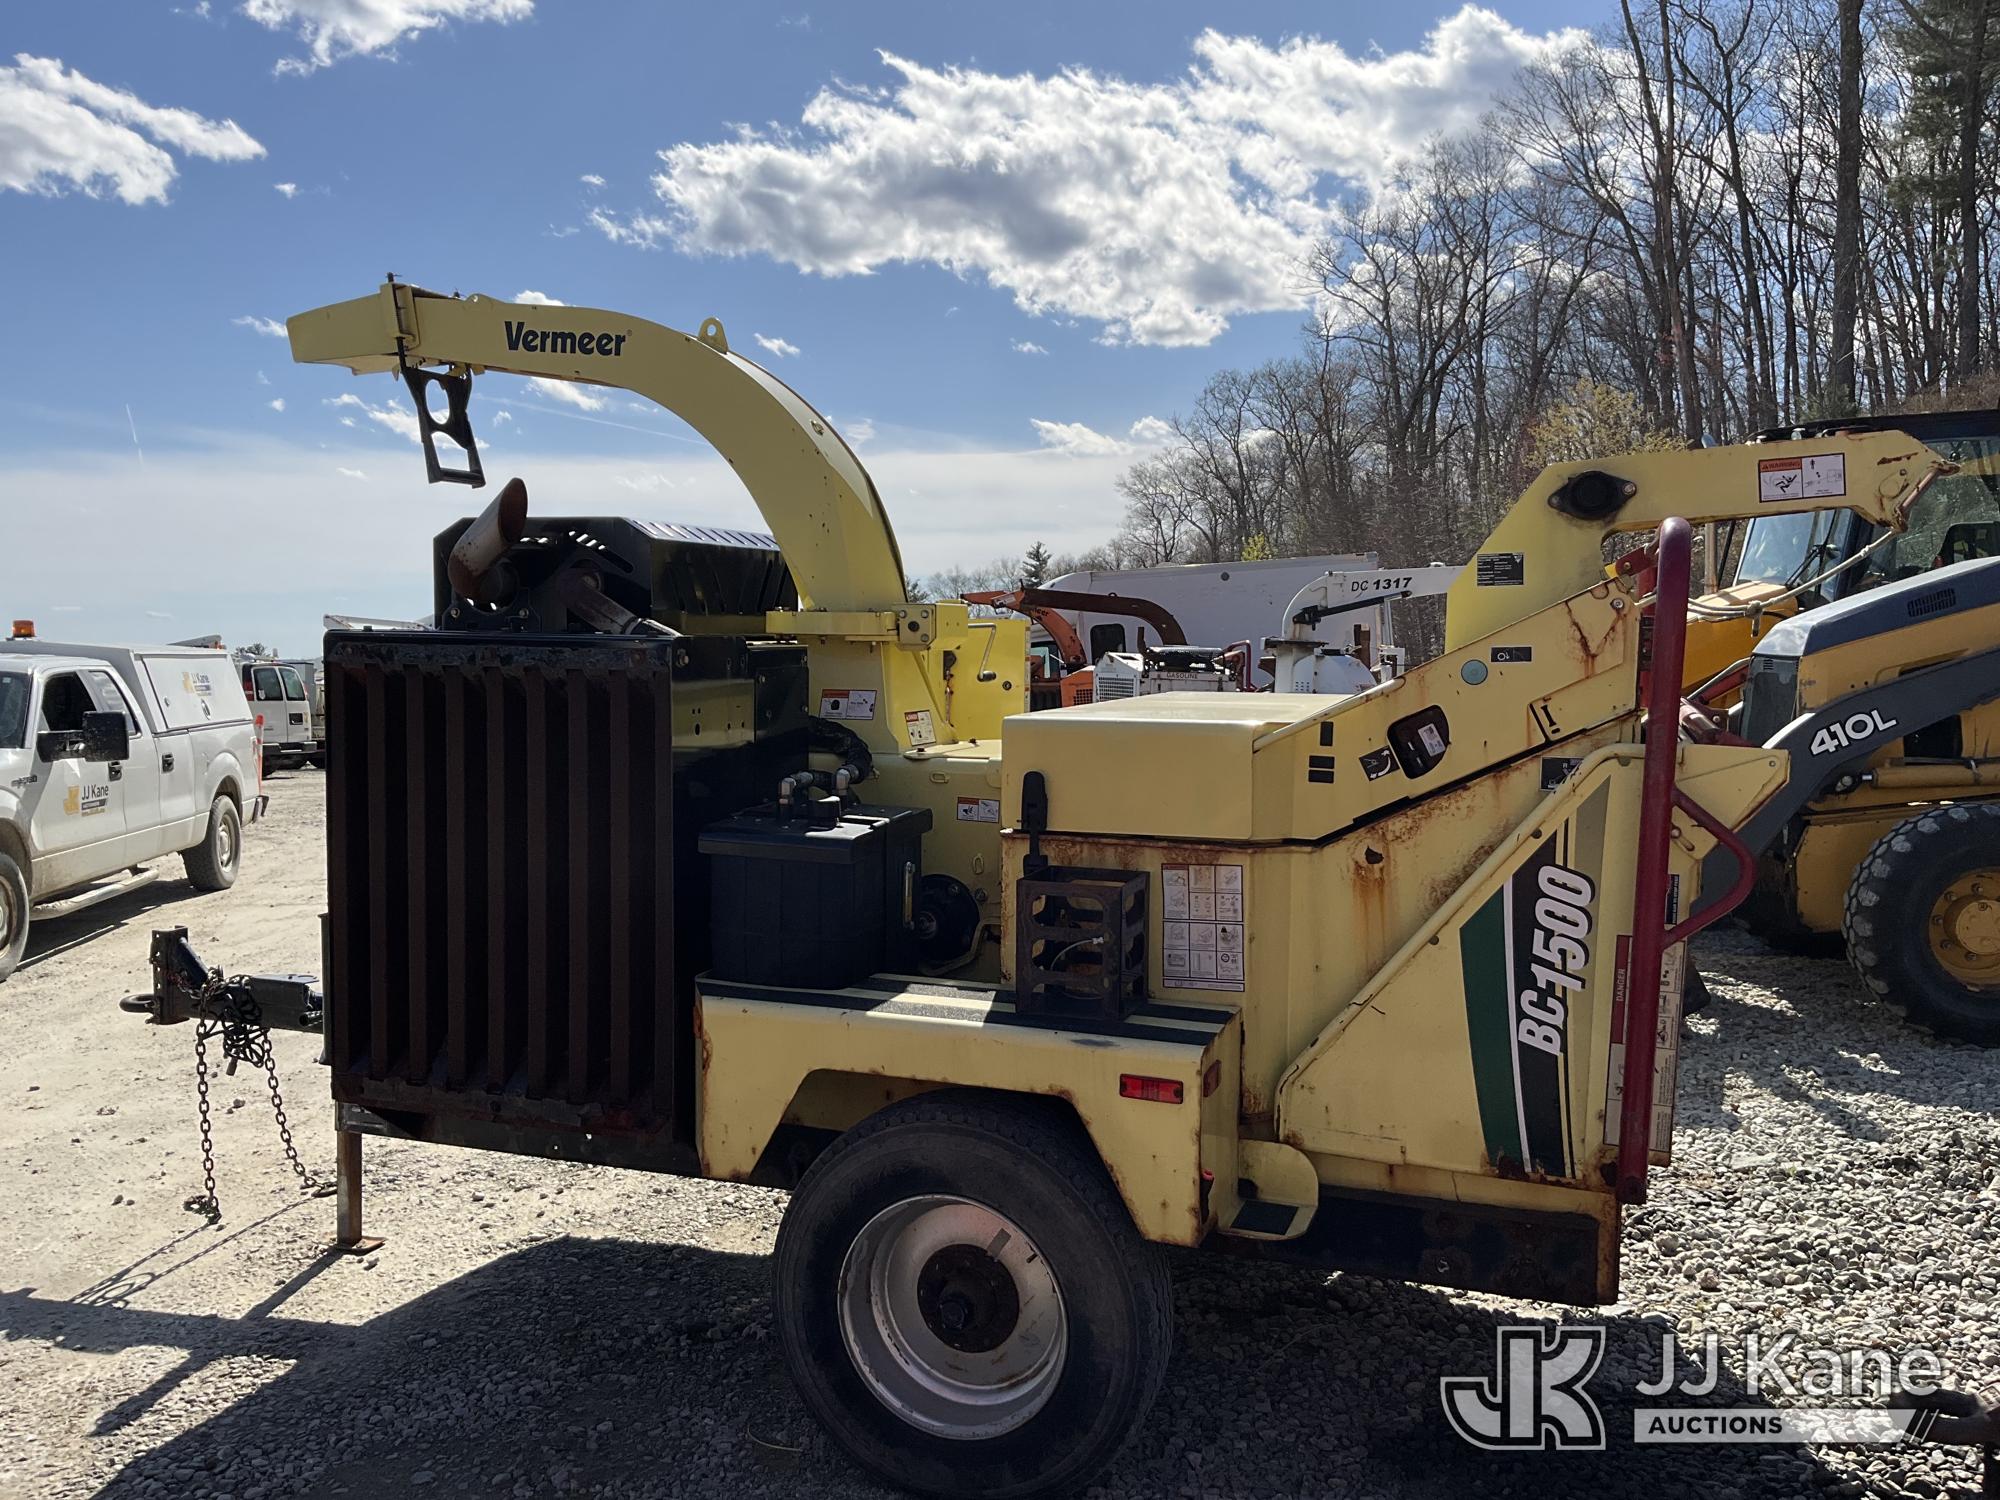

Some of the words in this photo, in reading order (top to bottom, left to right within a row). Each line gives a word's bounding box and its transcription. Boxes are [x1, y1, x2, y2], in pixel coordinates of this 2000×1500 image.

[504, 321, 626, 357] Vermeer
[1351, 581, 1369, 592] DC
[1373, 577, 1412, 590] 1317
[1811, 710, 1897, 755] 410L
[81, 785, 90, 800] JJ
[91, 784, 109, 798] Kane
[1518, 865, 1595, 1056] BC1500
[1616, 968, 1626, 1002] DANGER
